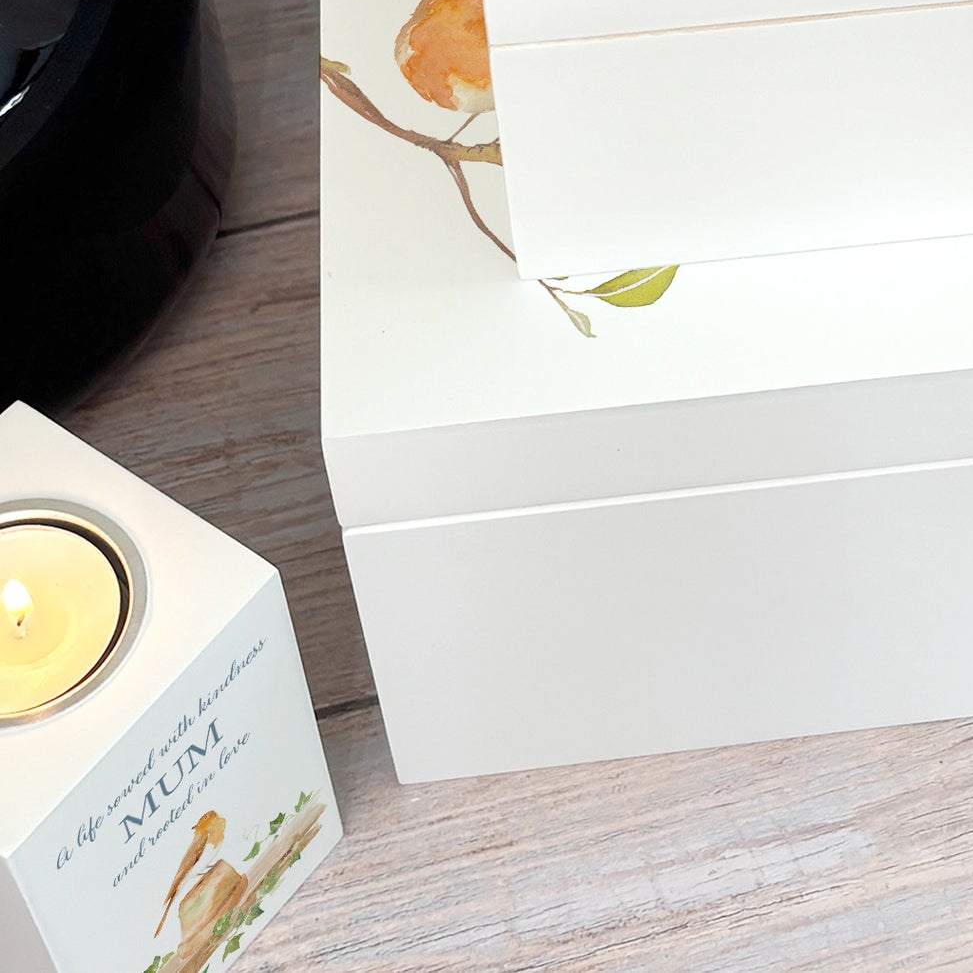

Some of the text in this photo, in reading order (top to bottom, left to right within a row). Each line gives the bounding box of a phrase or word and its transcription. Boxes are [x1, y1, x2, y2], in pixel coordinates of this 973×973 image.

[76, 815, 104, 847] life
[106, 748, 156, 816] sowed
[158, 714, 196, 757] with
[198, 638, 266, 717] kindness
[112, 732, 251, 888] and rooted in love
[118, 717, 224, 845] MUM
